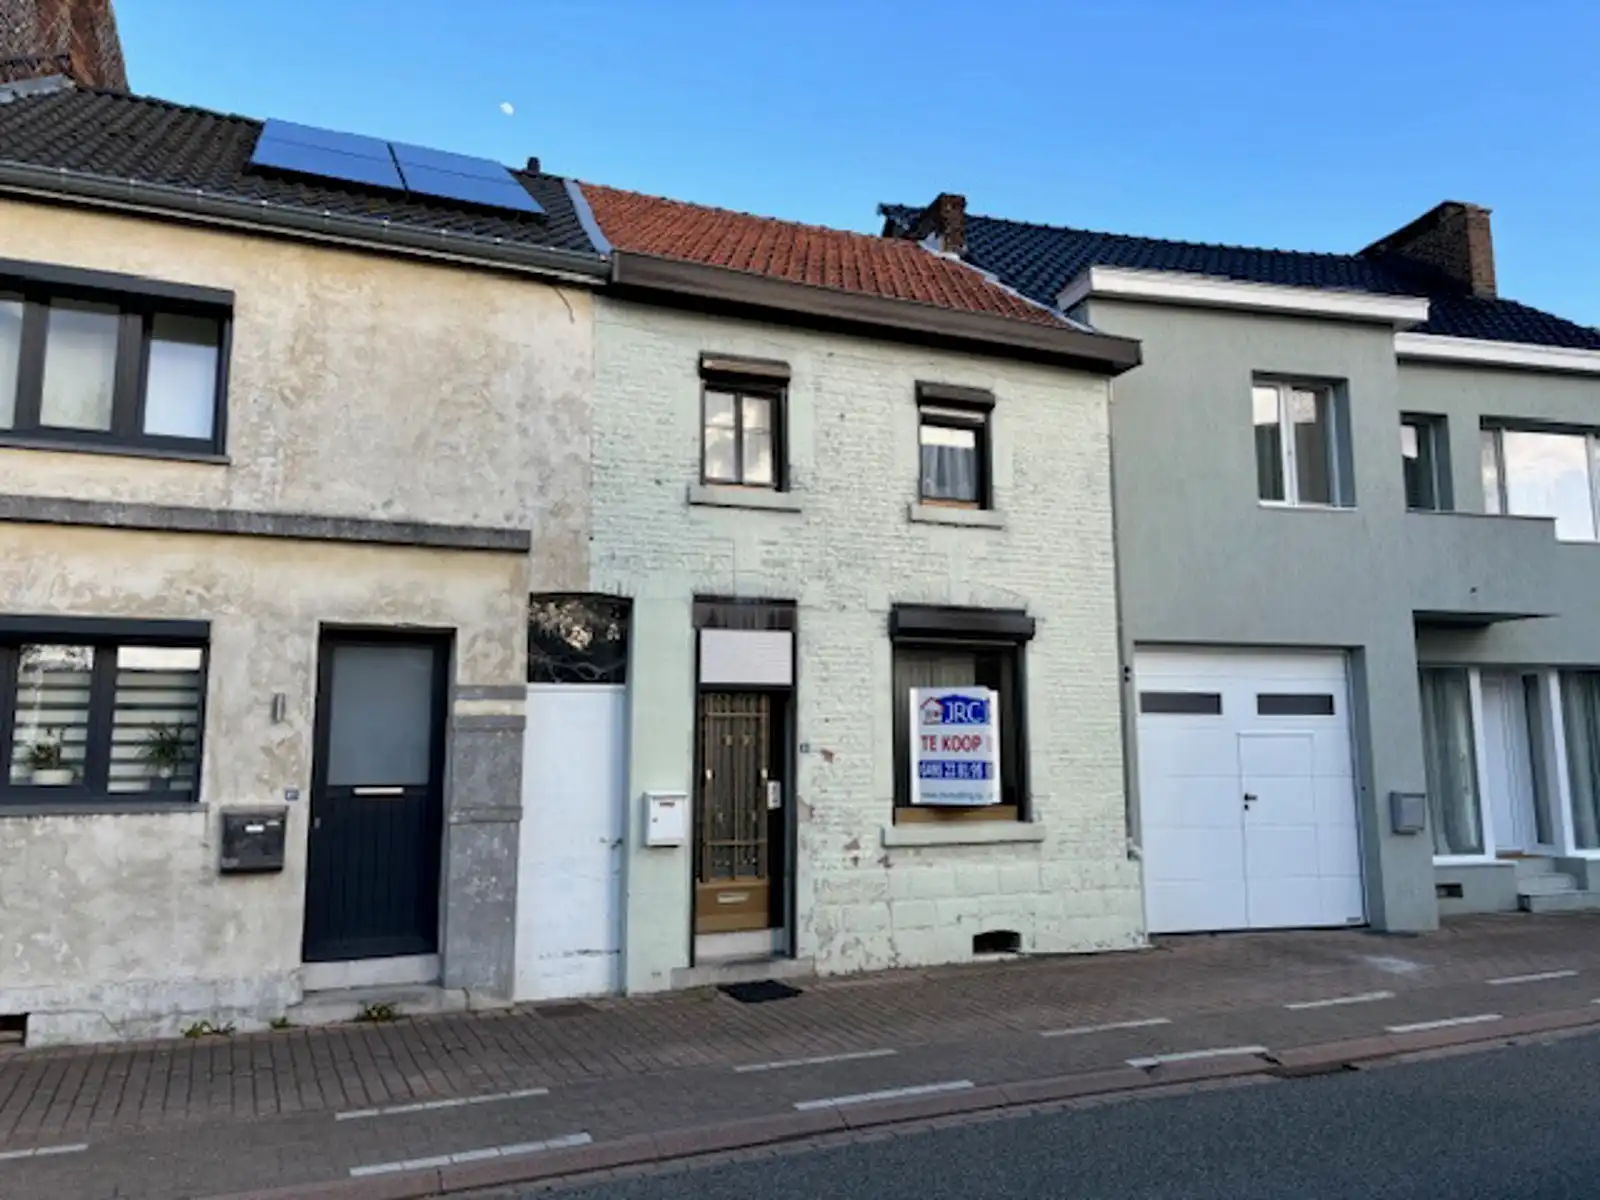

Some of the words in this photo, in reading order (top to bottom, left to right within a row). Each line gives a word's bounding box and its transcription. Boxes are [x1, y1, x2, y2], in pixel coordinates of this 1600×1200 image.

[944, 701, 983, 723] JRC
[920, 734, 938, 752] TE
[941, 734, 982, 753] KOOP
